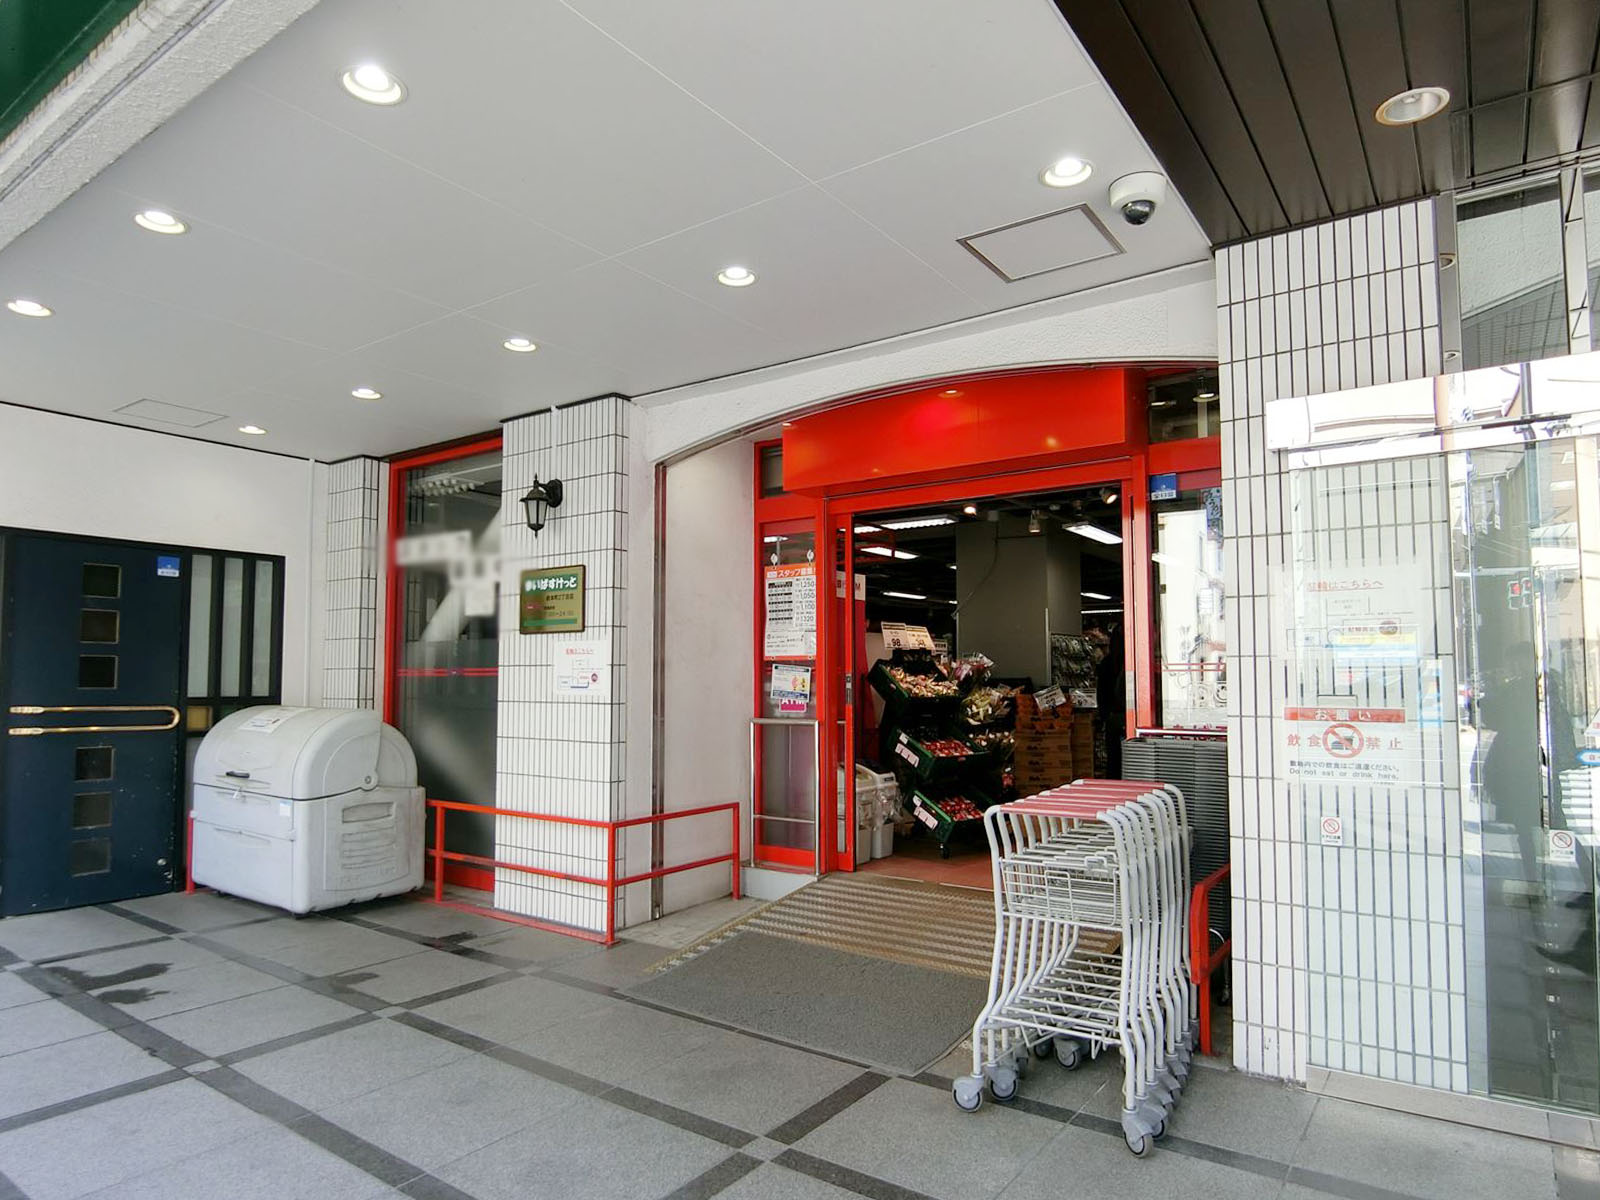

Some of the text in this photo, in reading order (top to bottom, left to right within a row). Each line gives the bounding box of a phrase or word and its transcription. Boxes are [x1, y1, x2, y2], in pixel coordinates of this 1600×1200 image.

[1314, 709, 1371, 721] お願い
[1287, 734, 1404, 750] 飲食 禁止
